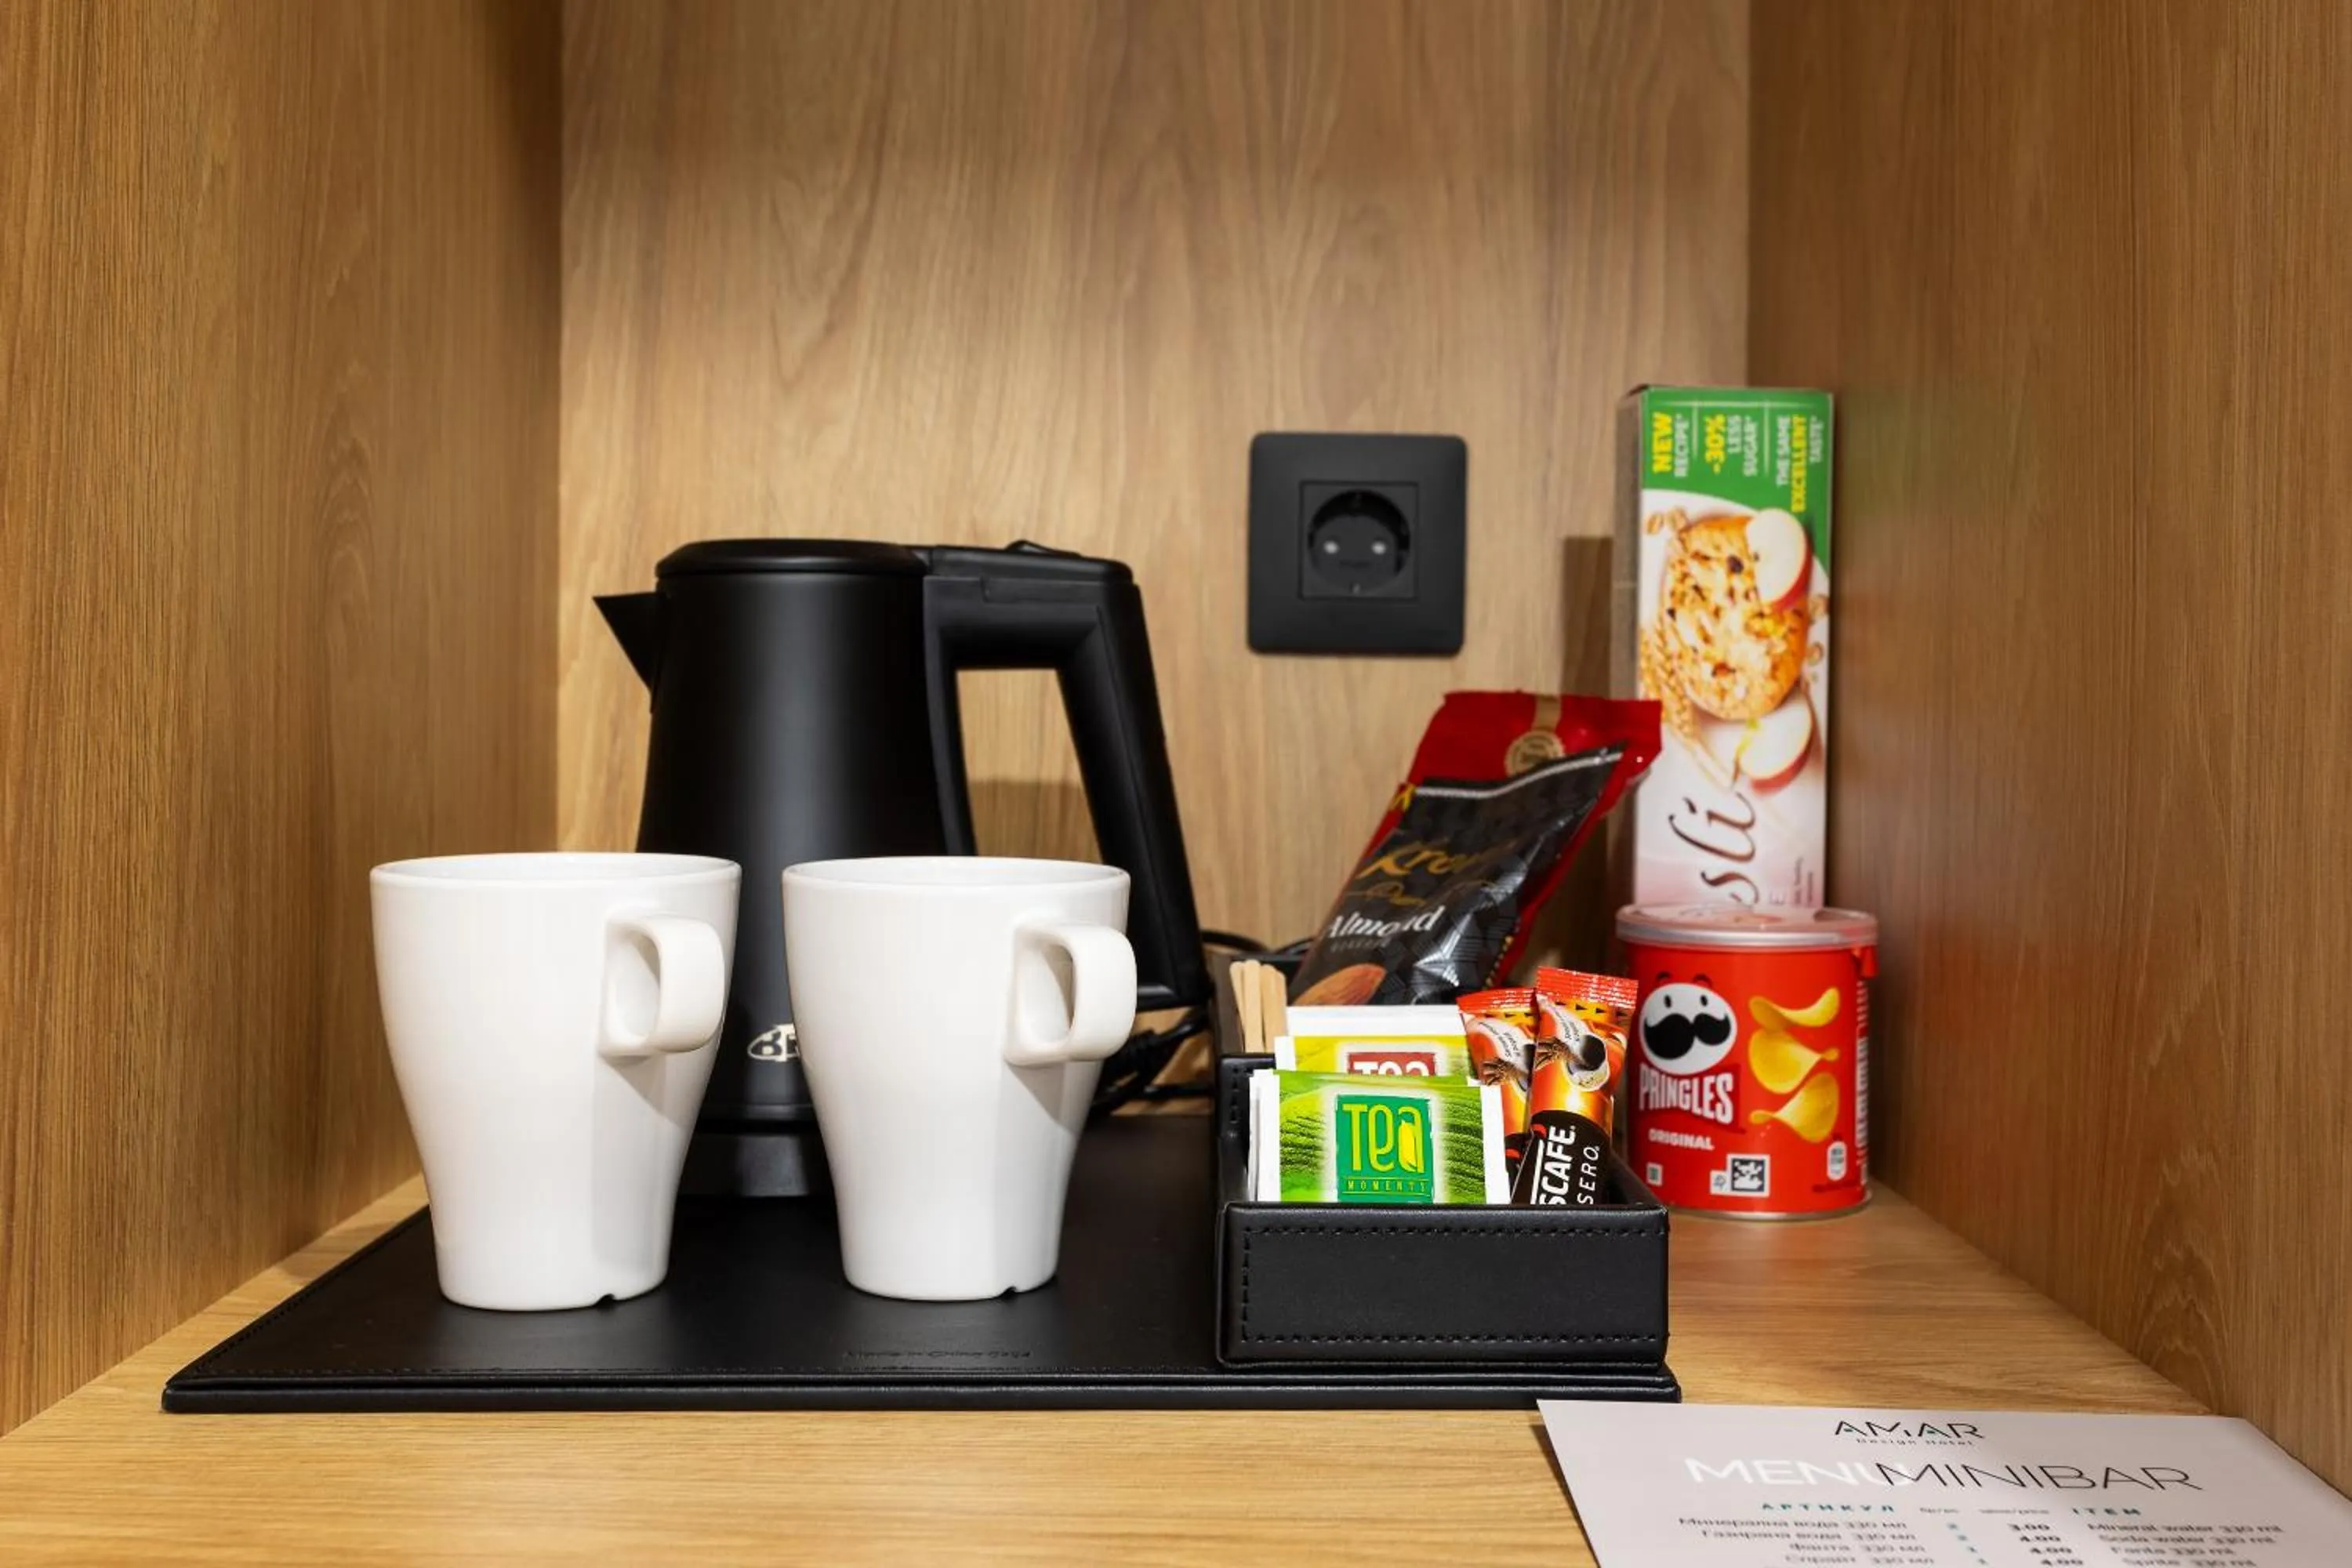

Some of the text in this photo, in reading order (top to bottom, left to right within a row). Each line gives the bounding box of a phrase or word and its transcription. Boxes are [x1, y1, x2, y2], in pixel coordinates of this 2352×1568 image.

[1652, 412, 1672, 474] NEW
[1704, 413, 1726, 474] -30%
[1791, 414, 1806, 514] EXCELLENT
[1639, 1062, 1733, 1124] PRINGLES
[1649, 1128, 1715, 1150] ORIGINAL
[1835, 1421, 1985, 1439] AMAR
[1856, 1438, 1917, 1446] Design
[1684, 1457, 2203, 1490] MENU MINIBAR
